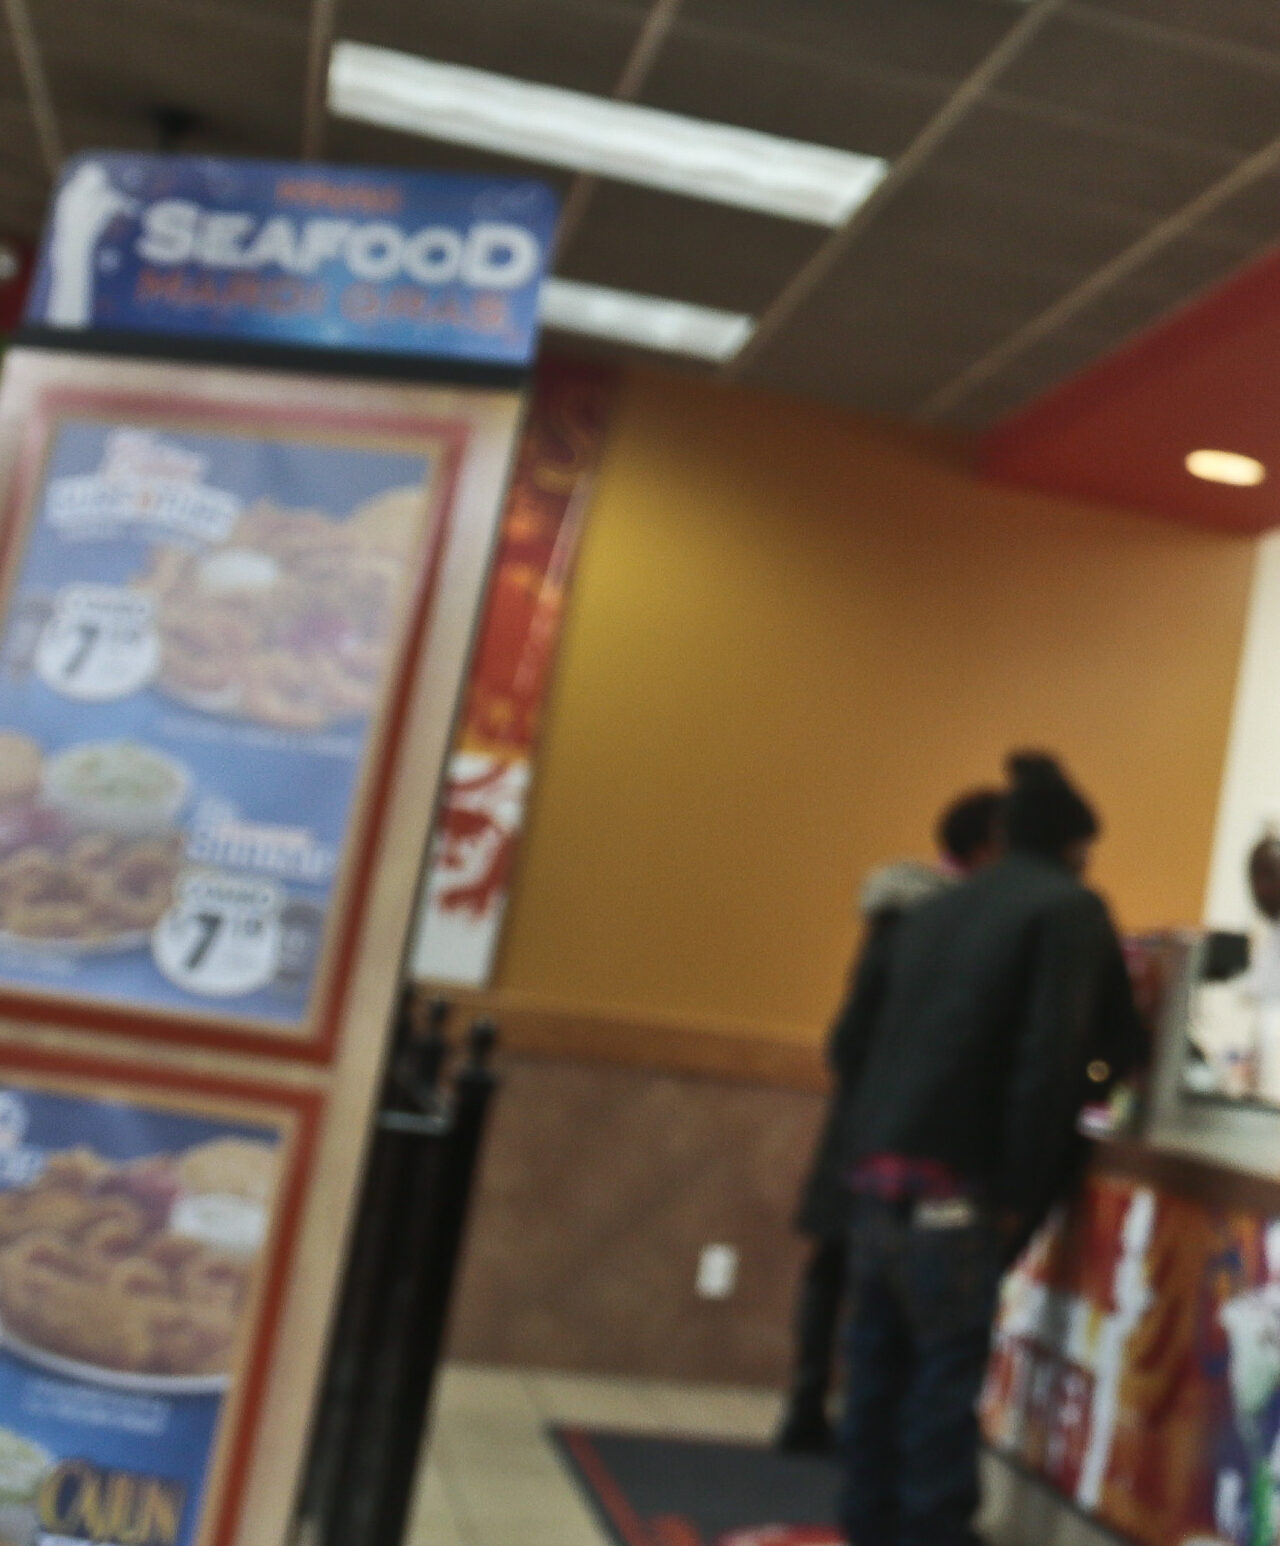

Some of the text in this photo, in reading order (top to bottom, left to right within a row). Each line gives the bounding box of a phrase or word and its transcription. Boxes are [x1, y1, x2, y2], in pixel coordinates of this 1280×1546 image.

[139, 200, 540, 290] SEAFOOD
[136, 268, 326, 316] MARDI
[185, 911, 224, 970] 7
